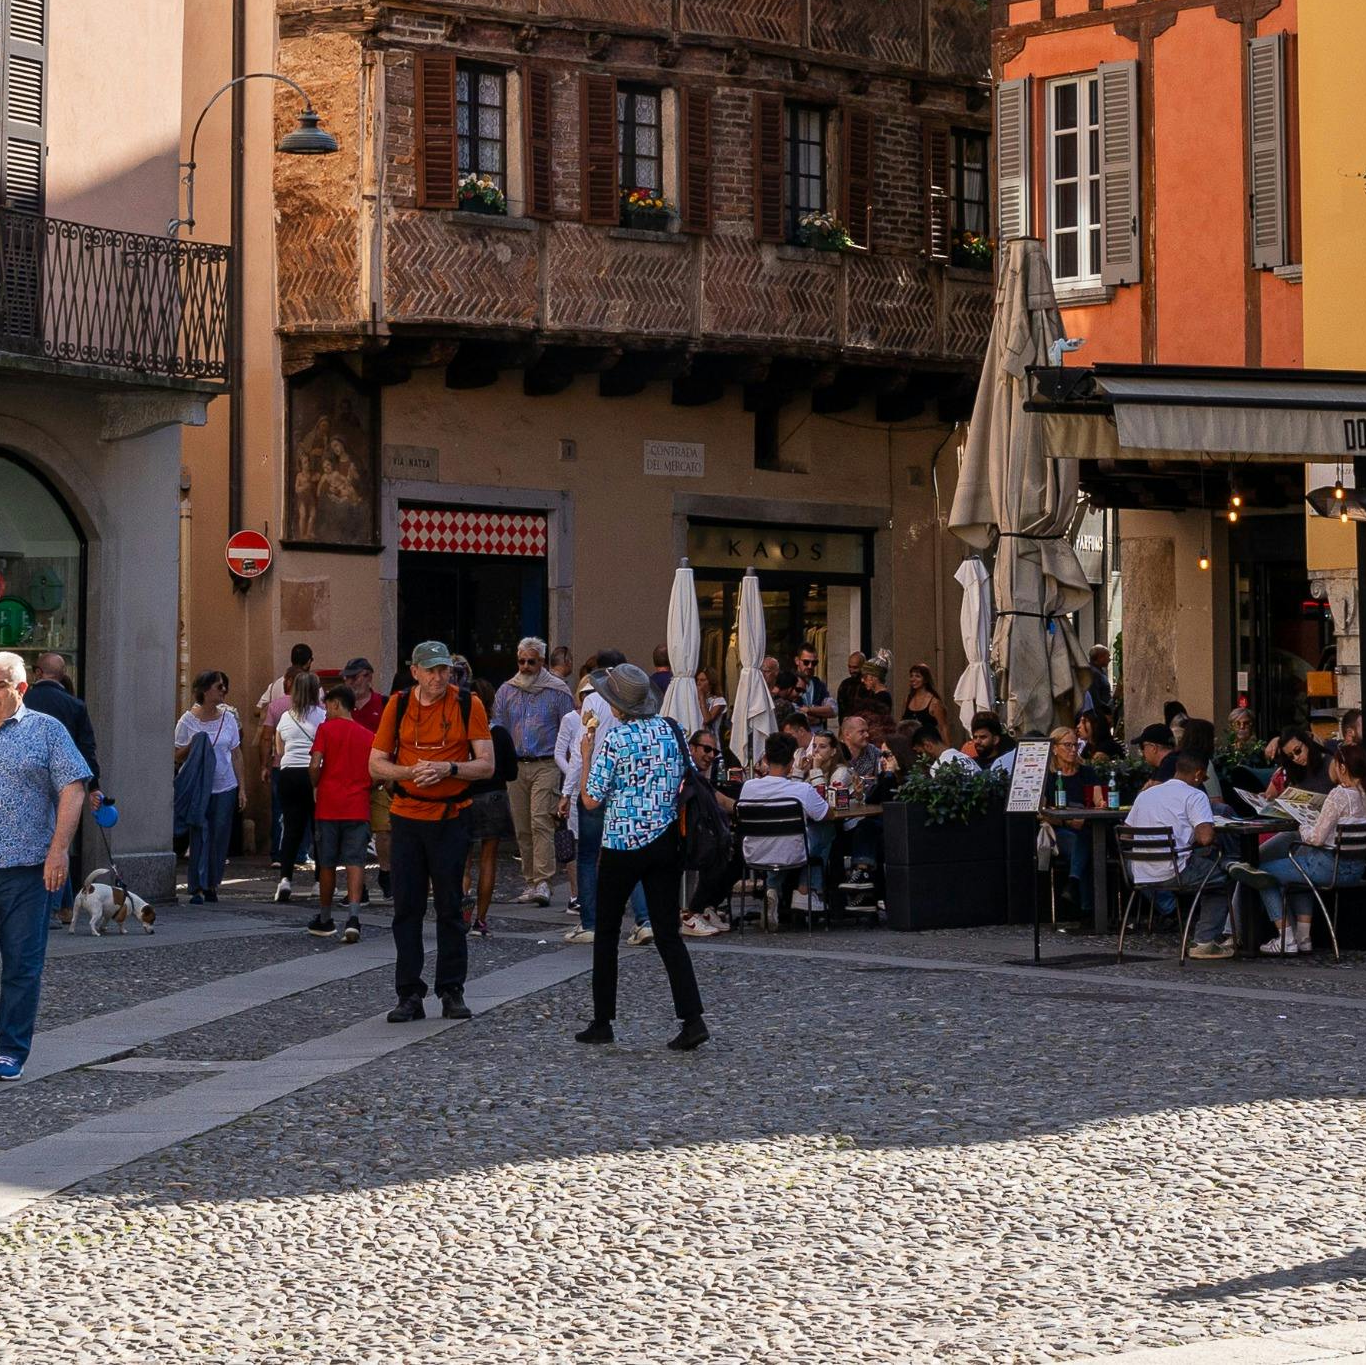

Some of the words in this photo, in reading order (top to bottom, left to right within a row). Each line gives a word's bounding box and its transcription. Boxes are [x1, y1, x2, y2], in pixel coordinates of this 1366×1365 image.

[650, 446, 698, 458] CONTRADA
[392, 458, 404, 466] VIA
[646, 458, 660, 471] DEL
[664, 460, 702, 473] MERCATO
[728, 539, 822, 561] KAOS
